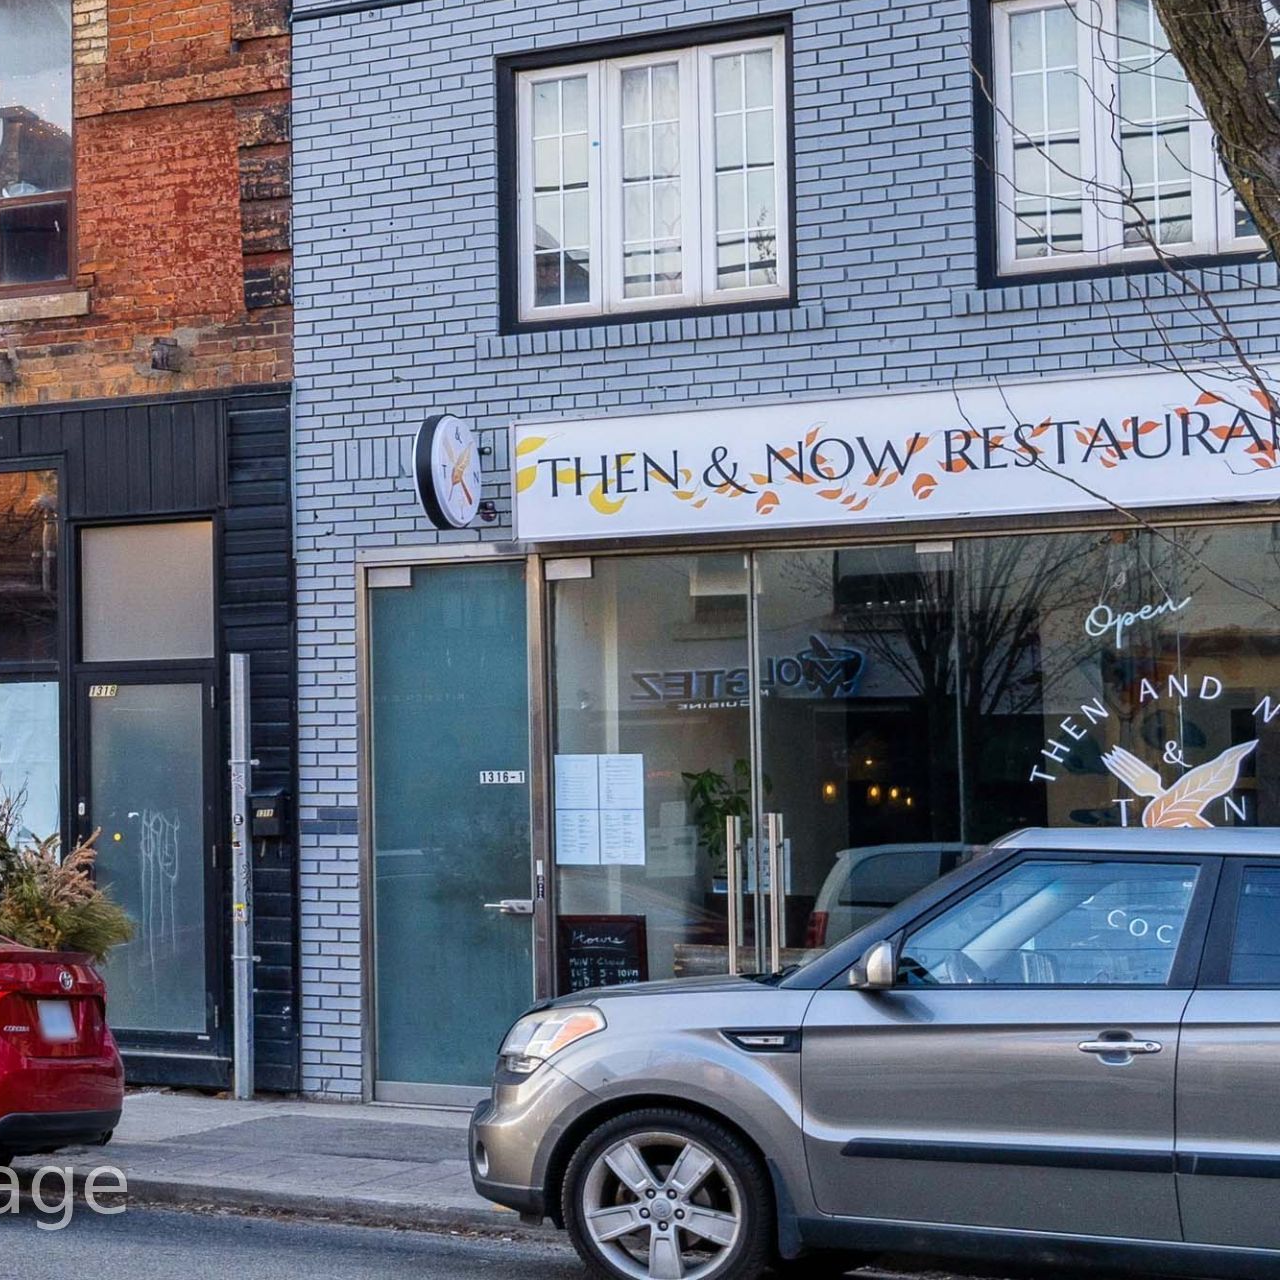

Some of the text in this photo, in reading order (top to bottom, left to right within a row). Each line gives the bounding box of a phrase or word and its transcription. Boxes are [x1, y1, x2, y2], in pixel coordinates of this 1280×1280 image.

[537, 449, 680, 498] THEN
[702, 446, 758, 495] &
[766, 432, 921, 484] NOW
[1084, 596, 1192, 649] Open
[1029, 697, 1111, 783] THEN
[1139, 673, 1223, 701] AND
[1162, 740, 1192, 768] &
[482, 771, 523, 783] 1316-1
[1111, 795, 1246, 827] T N
[1107, 909, 1174, 945] COC
